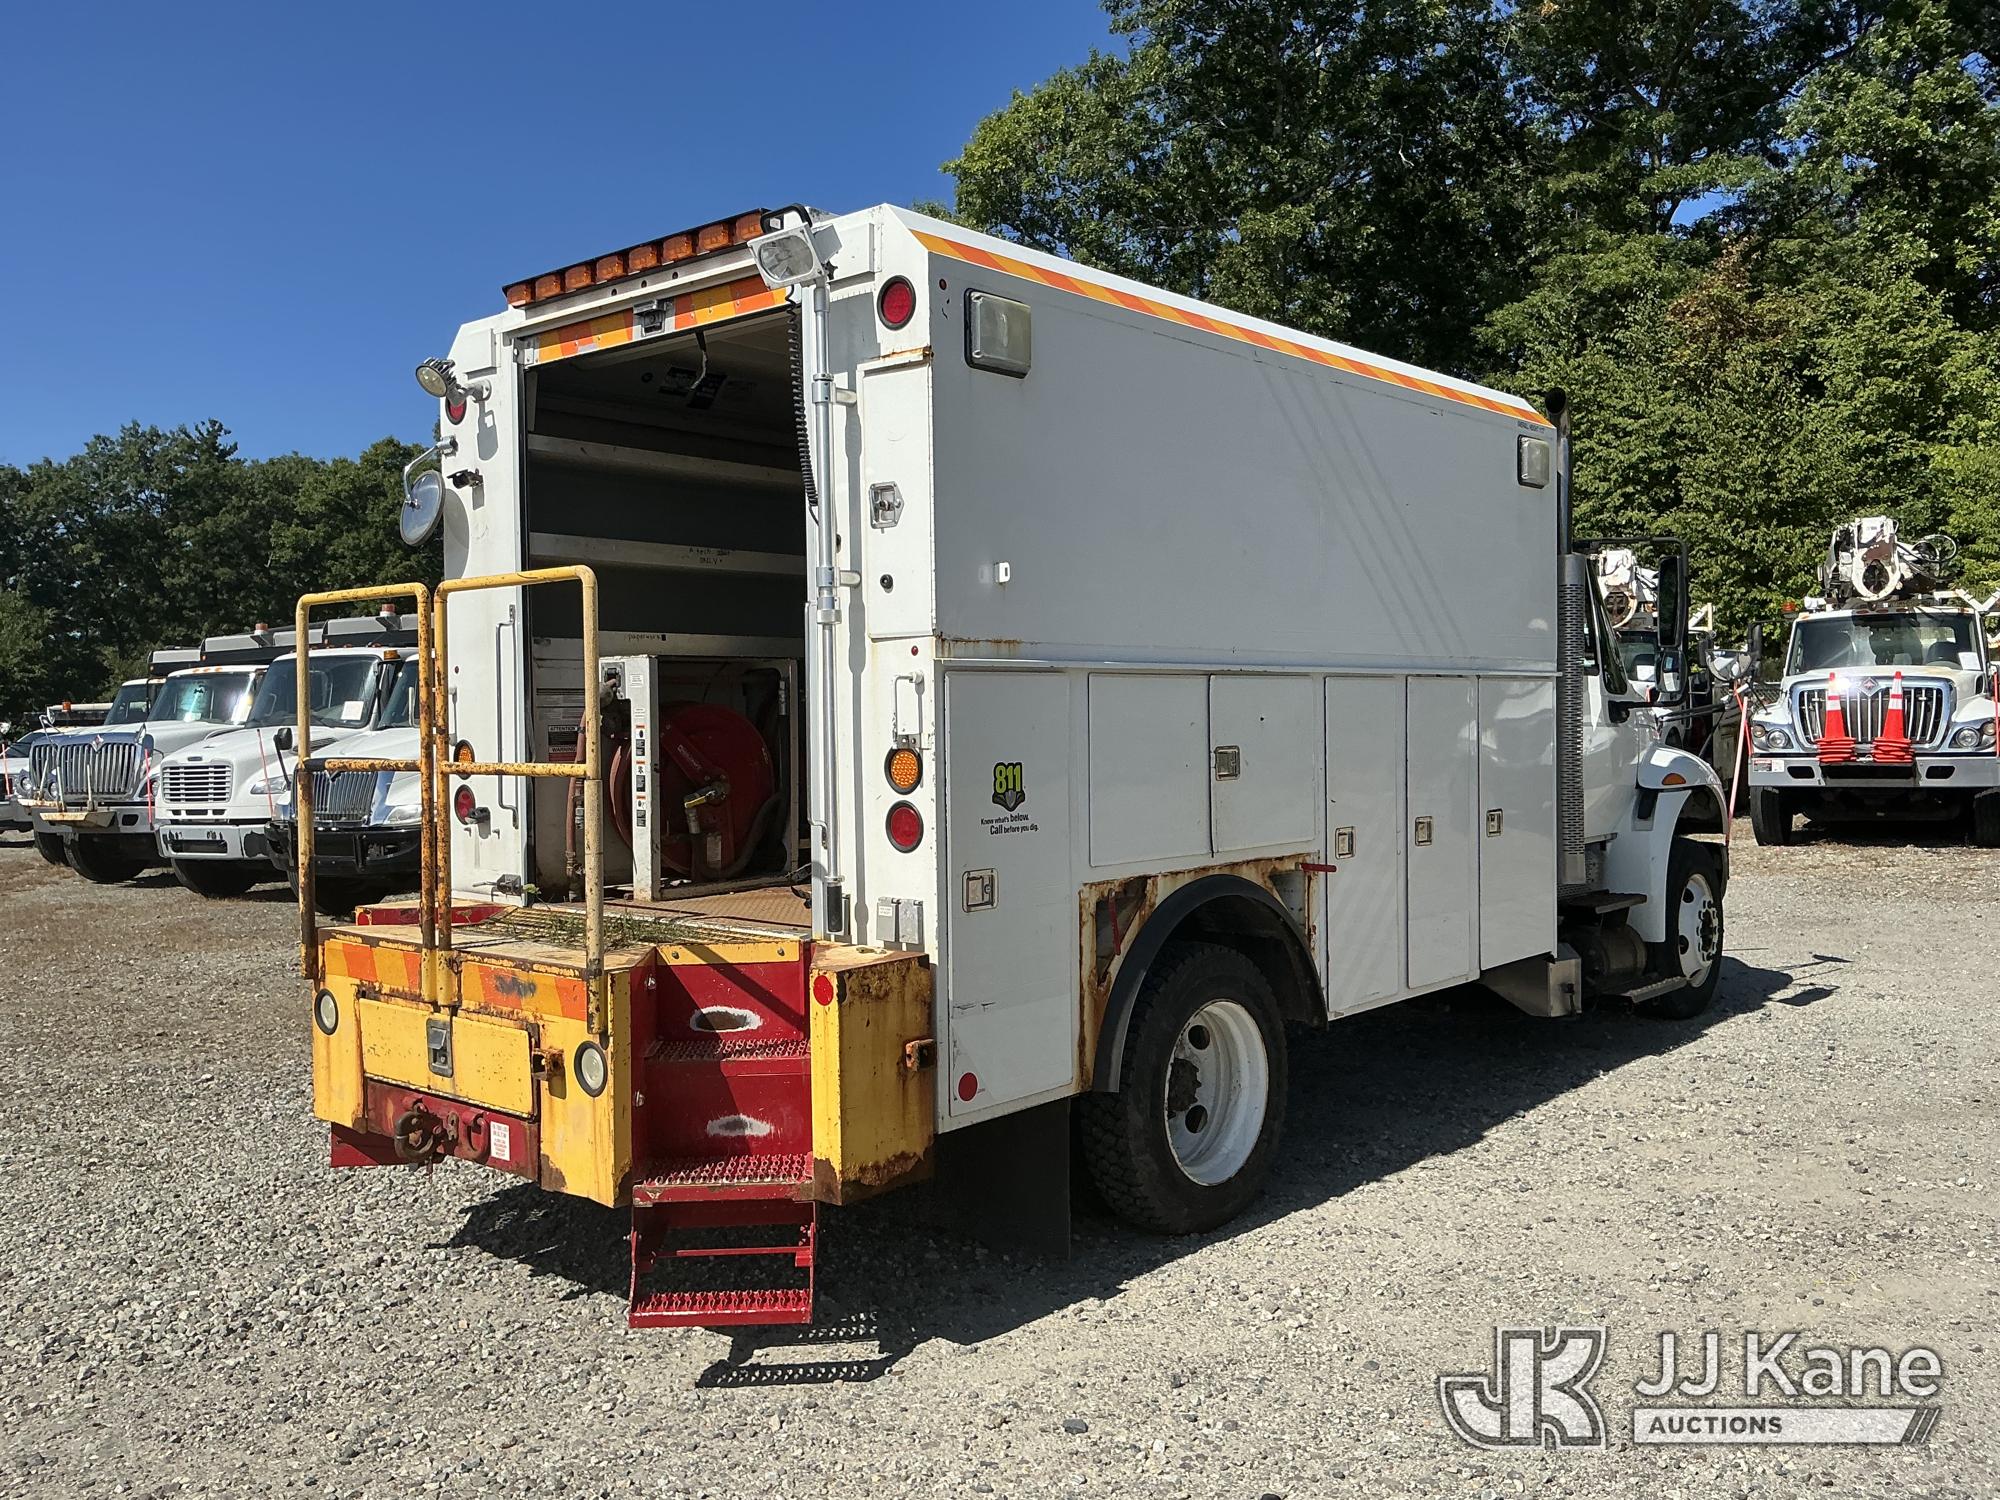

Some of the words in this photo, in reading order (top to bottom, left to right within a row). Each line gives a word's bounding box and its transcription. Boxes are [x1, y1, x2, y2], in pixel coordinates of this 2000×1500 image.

[993, 763, 1022, 794] 811
[1010, 813, 1029, 822] below.
[990, 824, 1003, 835] Call
[1020, 825, 1029, 833] you
